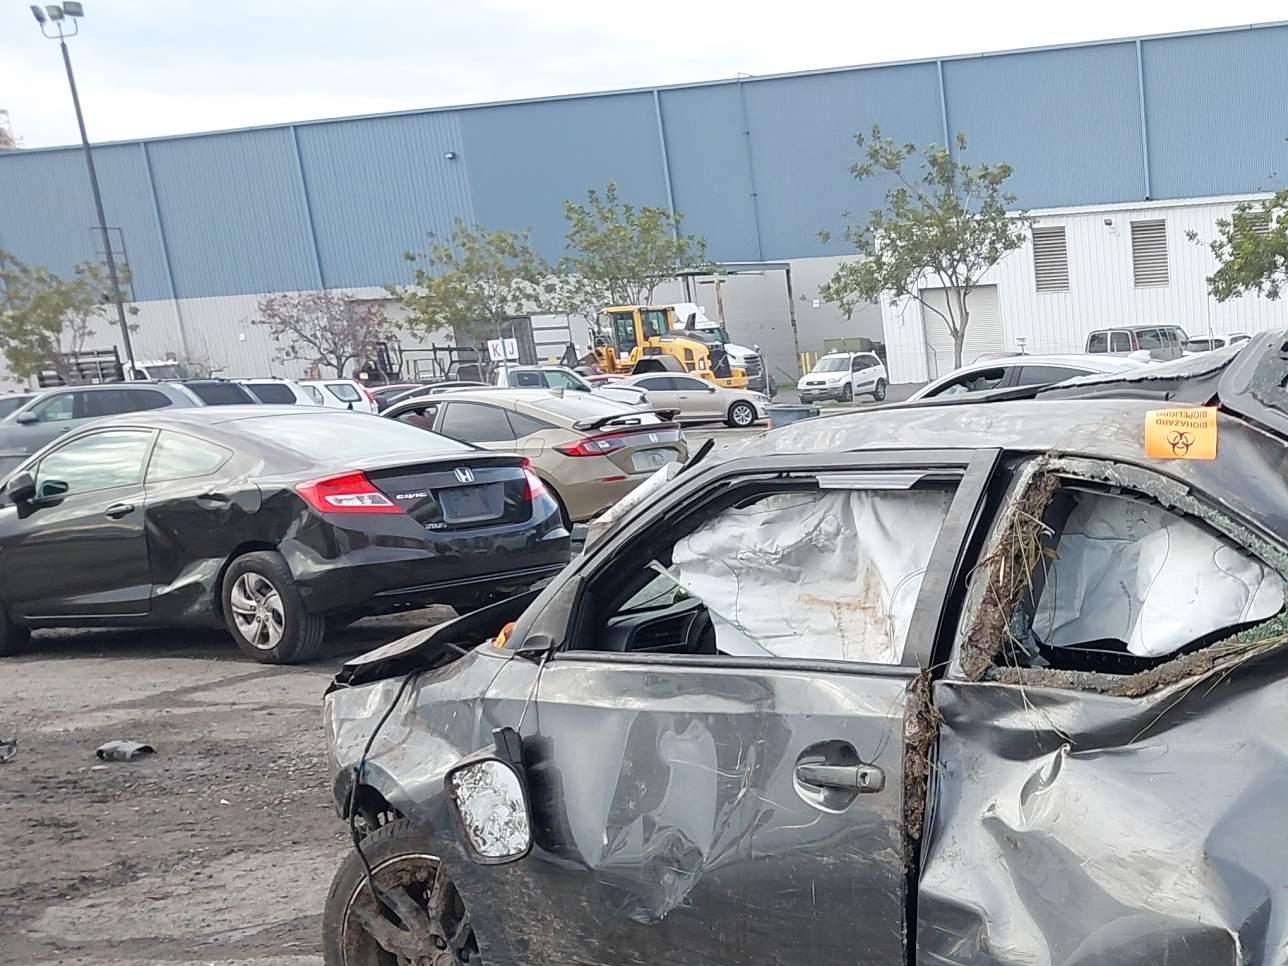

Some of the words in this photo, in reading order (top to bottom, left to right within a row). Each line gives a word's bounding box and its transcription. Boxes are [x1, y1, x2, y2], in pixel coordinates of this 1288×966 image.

[492, 343, 501, 358] K
[509, 342, 514, 355] J
[1155, 419, 1208, 429] BIOHAZARD
[396, 492, 427, 500] CIVIC
